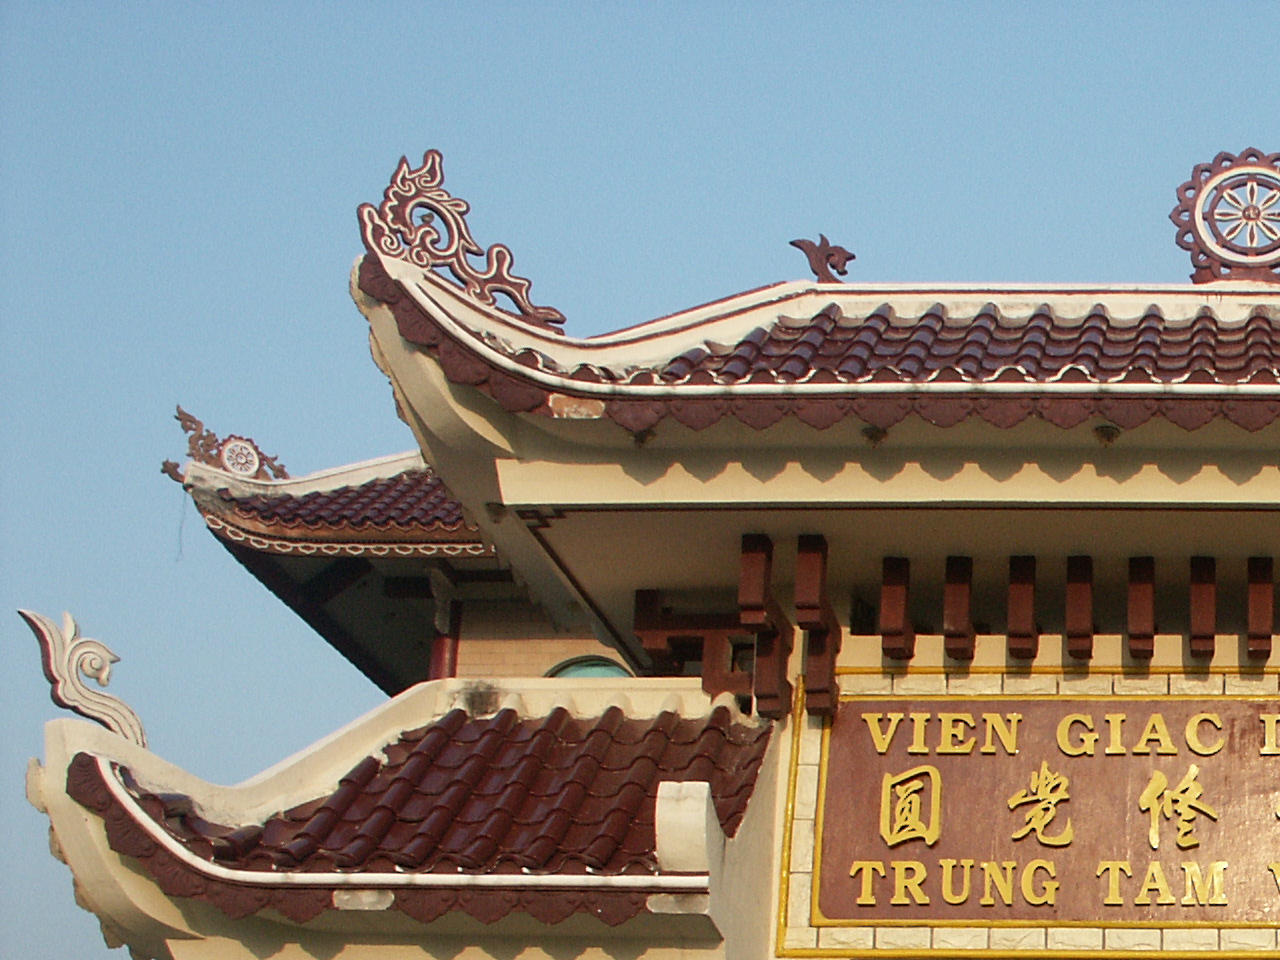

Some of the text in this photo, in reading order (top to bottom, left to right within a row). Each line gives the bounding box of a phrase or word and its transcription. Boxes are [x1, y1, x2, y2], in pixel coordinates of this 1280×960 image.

[862, 712, 1023, 755] VIEN
[1055, 712, 1227, 756] GIAC
[849, 858, 1060, 907] TRUNG
[1096, 860, 1229, 907] TAM
